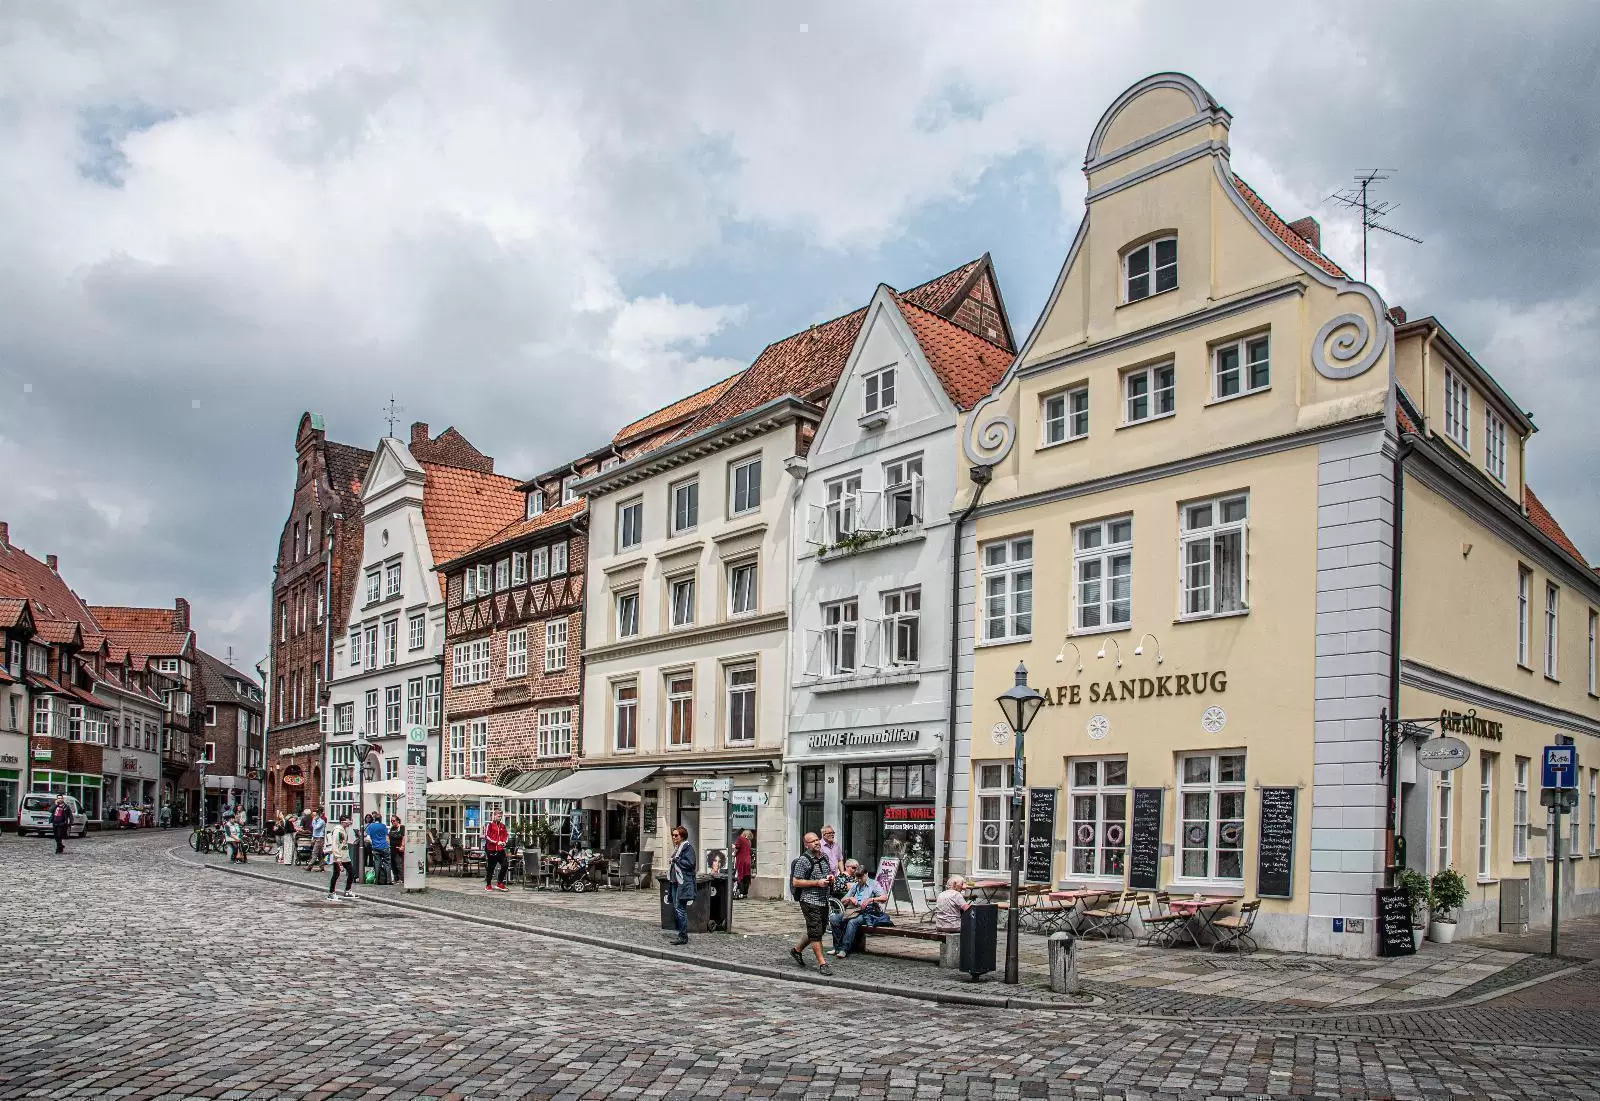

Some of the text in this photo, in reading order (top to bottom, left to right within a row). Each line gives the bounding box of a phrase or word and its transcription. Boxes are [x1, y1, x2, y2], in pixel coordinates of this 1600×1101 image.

[1089, 670, 1228, 703] SANDKRUG
[845, 728, 919, 745] Immobilien
[885, 807, 936, 820] STAR NAILS
